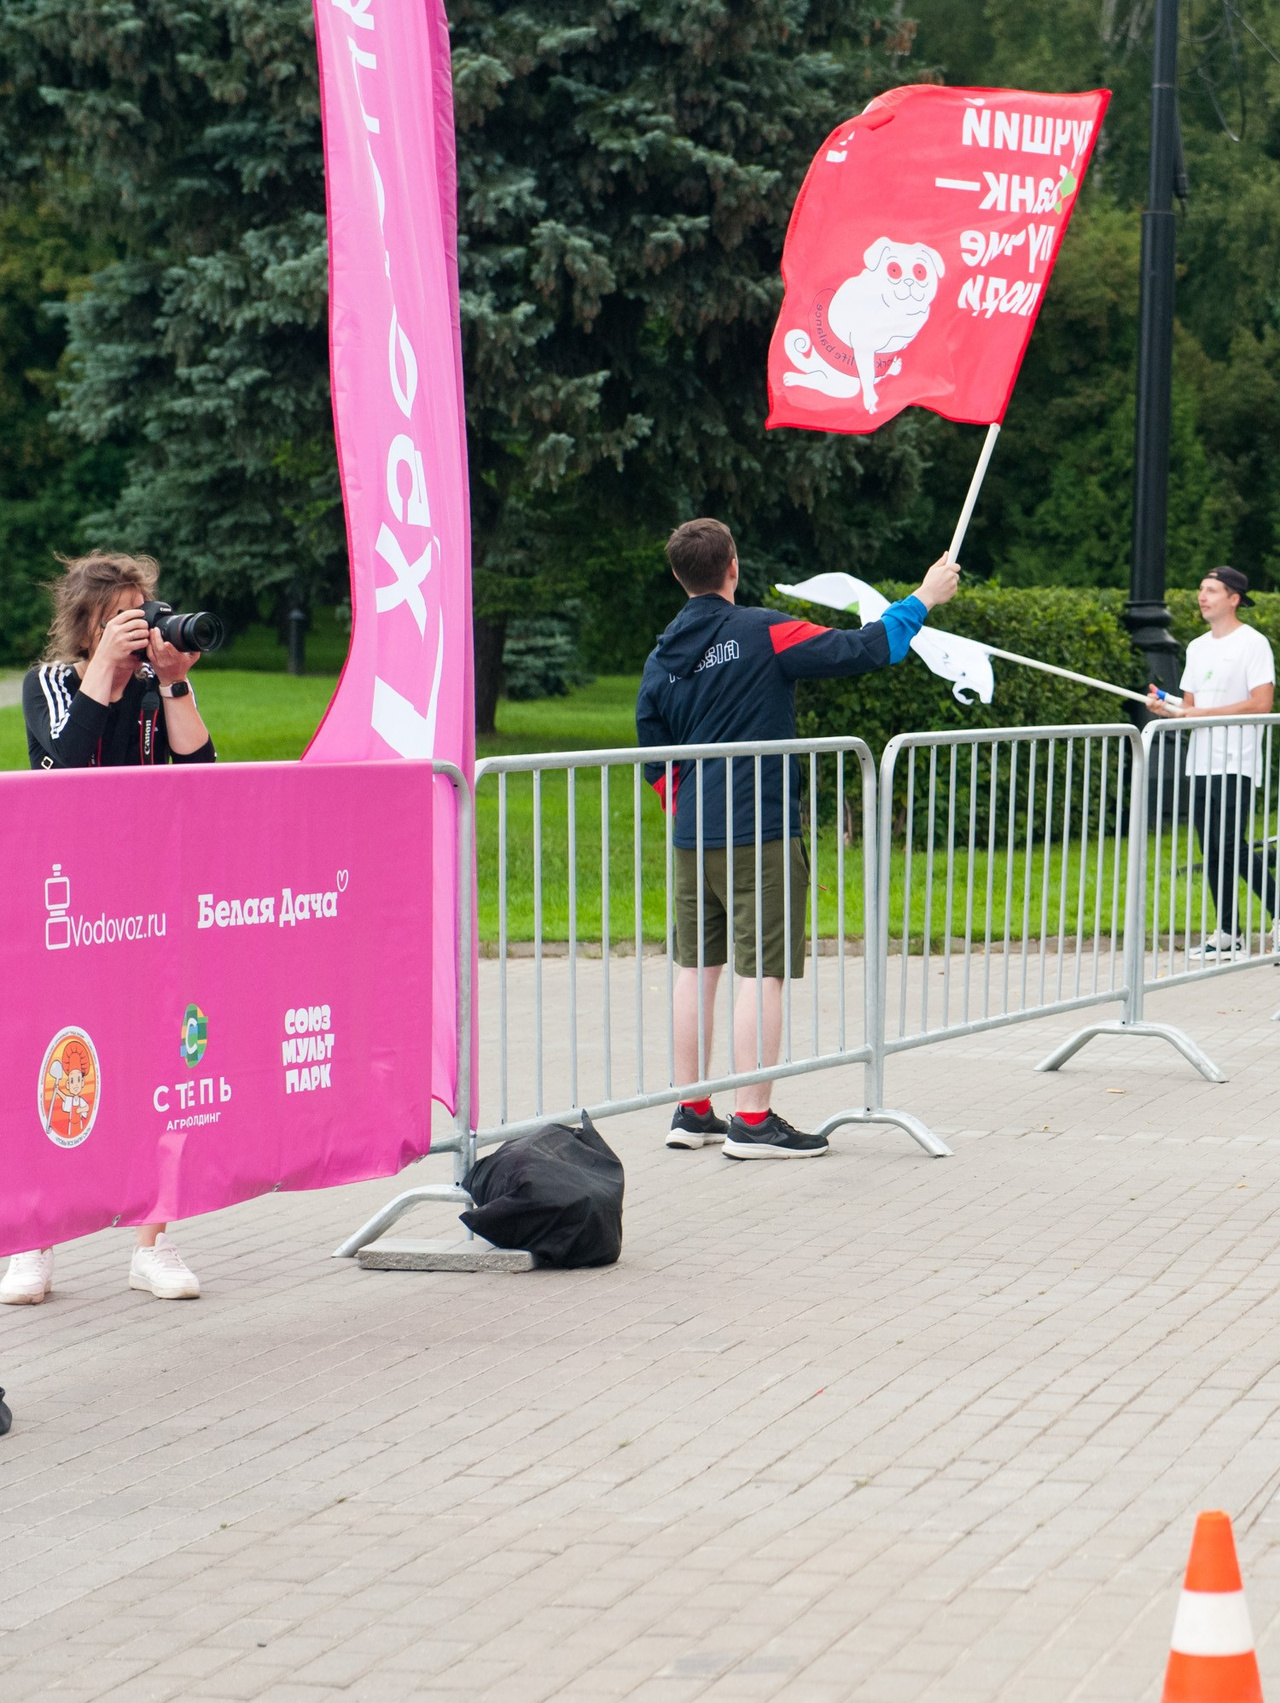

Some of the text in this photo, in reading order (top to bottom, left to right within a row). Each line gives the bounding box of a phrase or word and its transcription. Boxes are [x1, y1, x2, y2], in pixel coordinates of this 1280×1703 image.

[144, 719, 152, 755] Canon
[197, 888, 338, 929] Белая Дача
[70, 912, 167, 947] Vodovoz.ru
[284, 1004, 332, 1035] СОЮЗ
[282, 1033, 336, 1067] МУЛЬТ
[153, 1076, 232, 1113] СТЕПЬ
[285, 1063, 332, 1094] ПАРК
